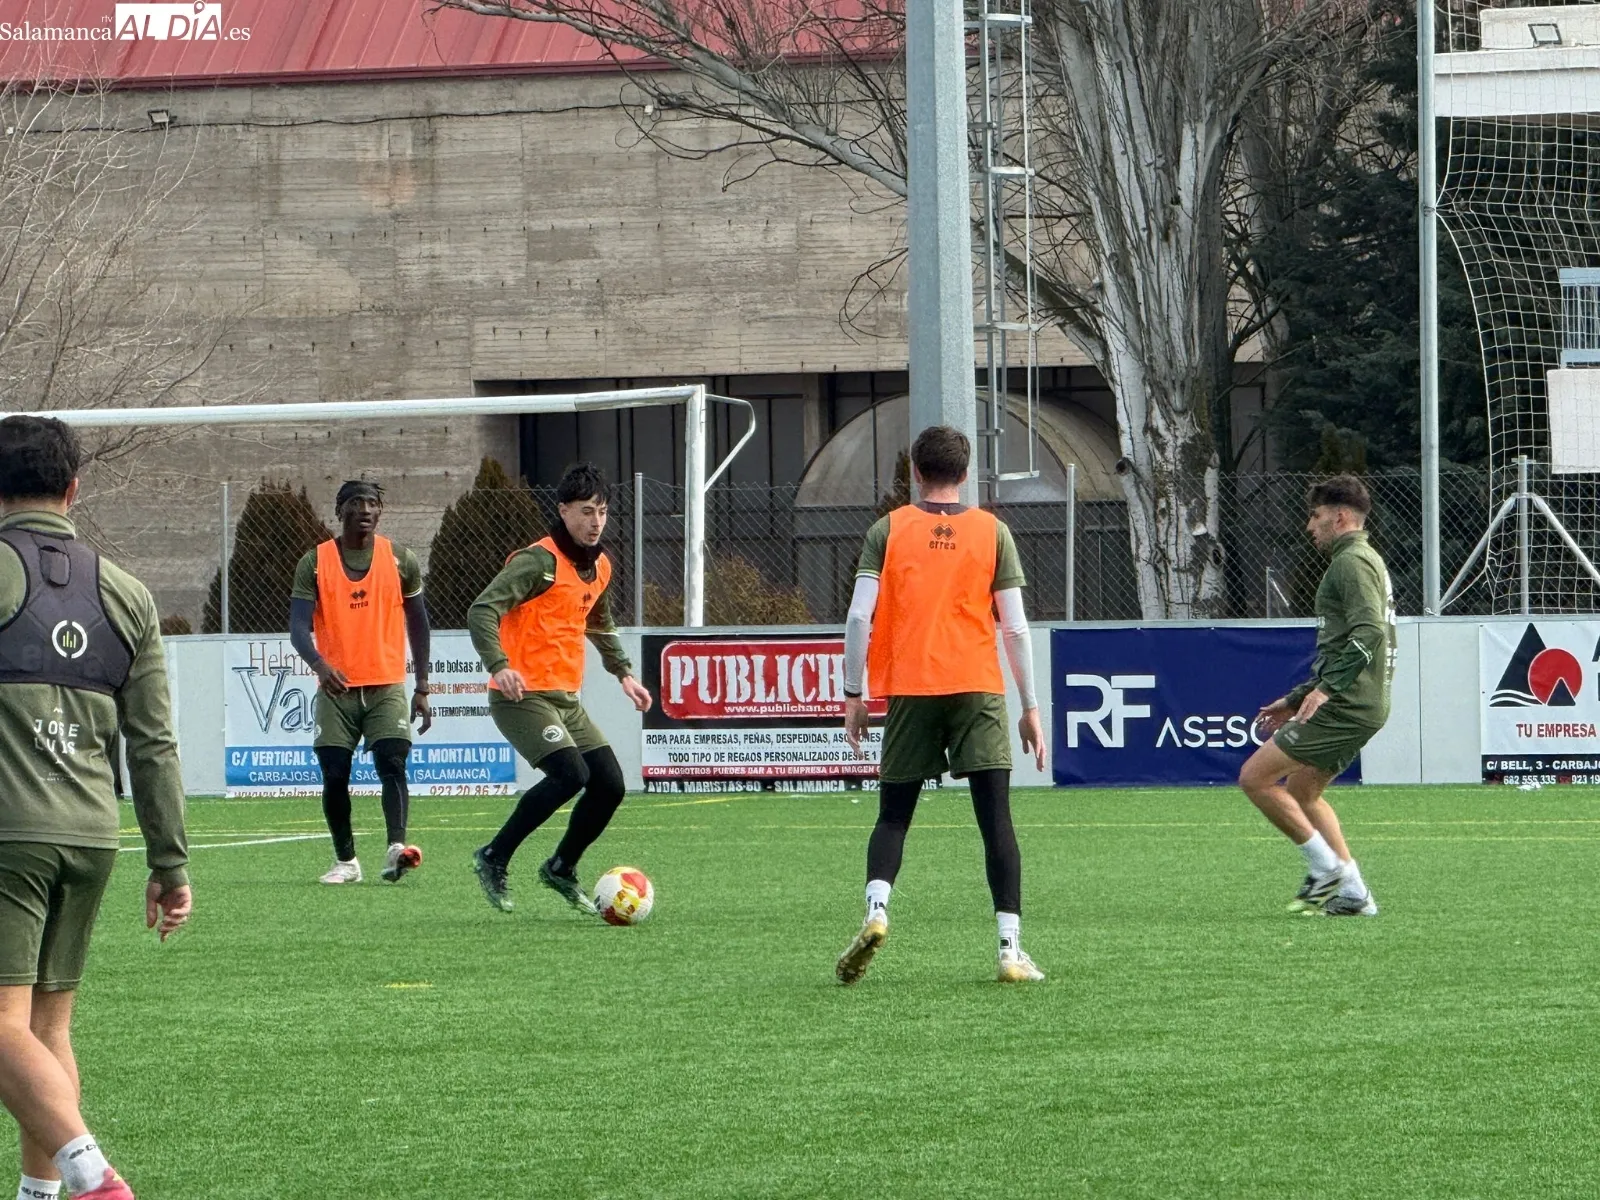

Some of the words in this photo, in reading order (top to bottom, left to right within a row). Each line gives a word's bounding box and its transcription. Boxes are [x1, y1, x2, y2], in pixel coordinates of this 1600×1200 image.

[435, 660, 446, 673] de
[446, 660, 474, 673] bolsas
[723, 703, 841, 714] www.publichan.es
[1515, 723, 1533, 738] TU
[1537, 723, 1597, 738] EMPRESA
[646, 734, 668, 745] ROPA
[669, 734, 691, 744] PARA
[693, 733, 741, 746] EMPRESAS,
[743, 732, 774, 745] PEÑAS,
[776, 733, 831, 744] DESPEDIDAS,
[231, 752, 248, 767] C/
[251, 751, 307, 767] VERTICAL
[411, 748, 425, 764] EL
[428, 747, 496, 763] MONTALVO
[500, 747, 510, 763] III
[668, 752, 690, 762] TODO
[692, 752, 711, 762] TIPO
[714, 752, 725, 762] DE
[727, 752, 762, 762] REGAOS
[764, 751, 840, 762] PERSONALIZADOS
[647, 767, 666, 775] CON
[713, 767, 746, 775] PUEDES
[787, 766, 827, 774] EMPRESA
[1486, 760, 1498, 770] C/
[1500, 760, 1534, 772] BELL,
[1536, 760, 1543, 770] 3
[249, 770, 318, 783] CARBAJOSA
[413, 768, 491, 783] (SALAMANCA)
[1571, 774, 1588, 785] 923
[774, 780, 846, 793] SALAMANCA
